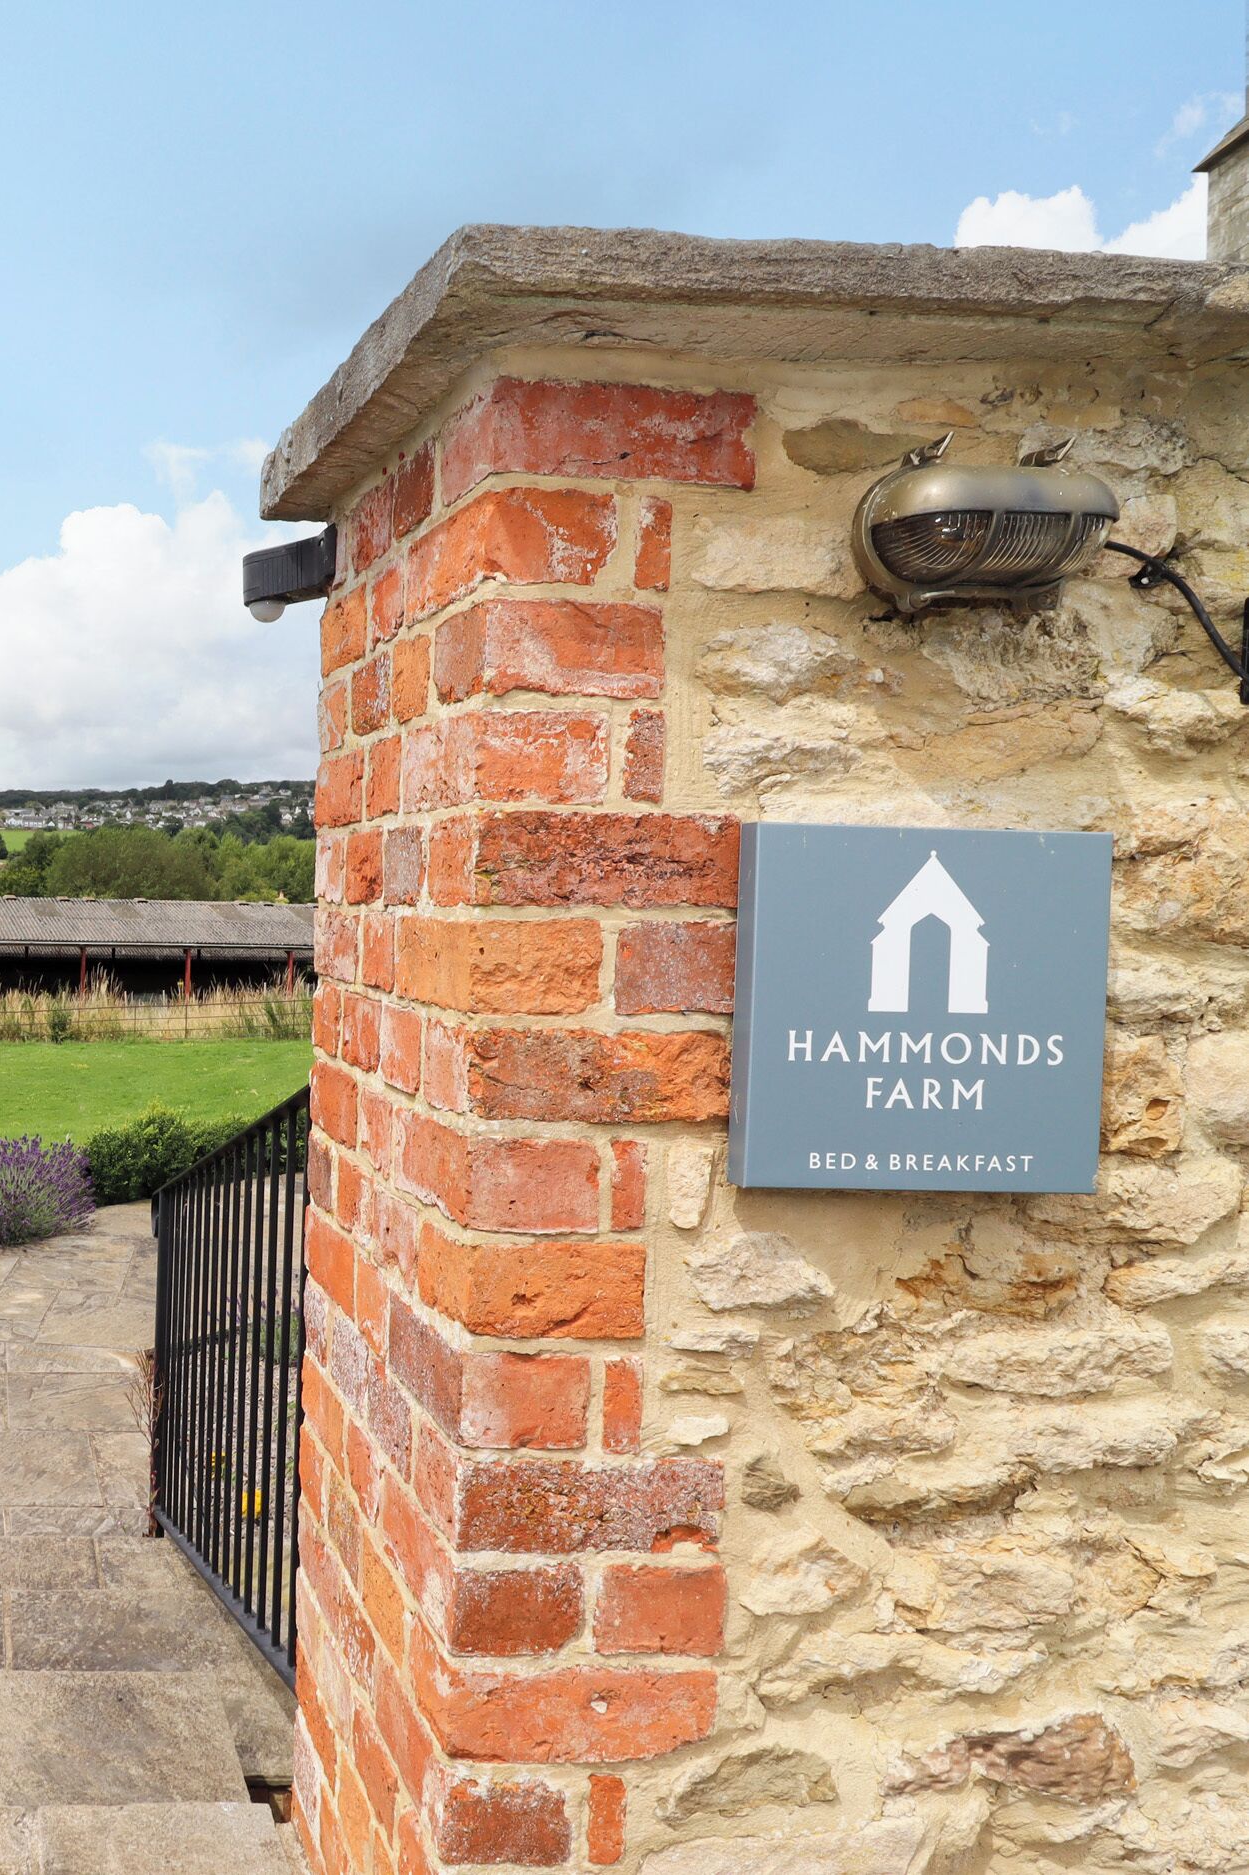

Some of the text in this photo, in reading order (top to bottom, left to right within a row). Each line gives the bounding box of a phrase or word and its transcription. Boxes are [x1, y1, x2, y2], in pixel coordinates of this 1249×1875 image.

[787, 1029, 1064, 1066] HAMMONDS
[865, 1077, 985, 1111] FARM
[809, 1152, 1034, 1173] BED & BREAKFAST
